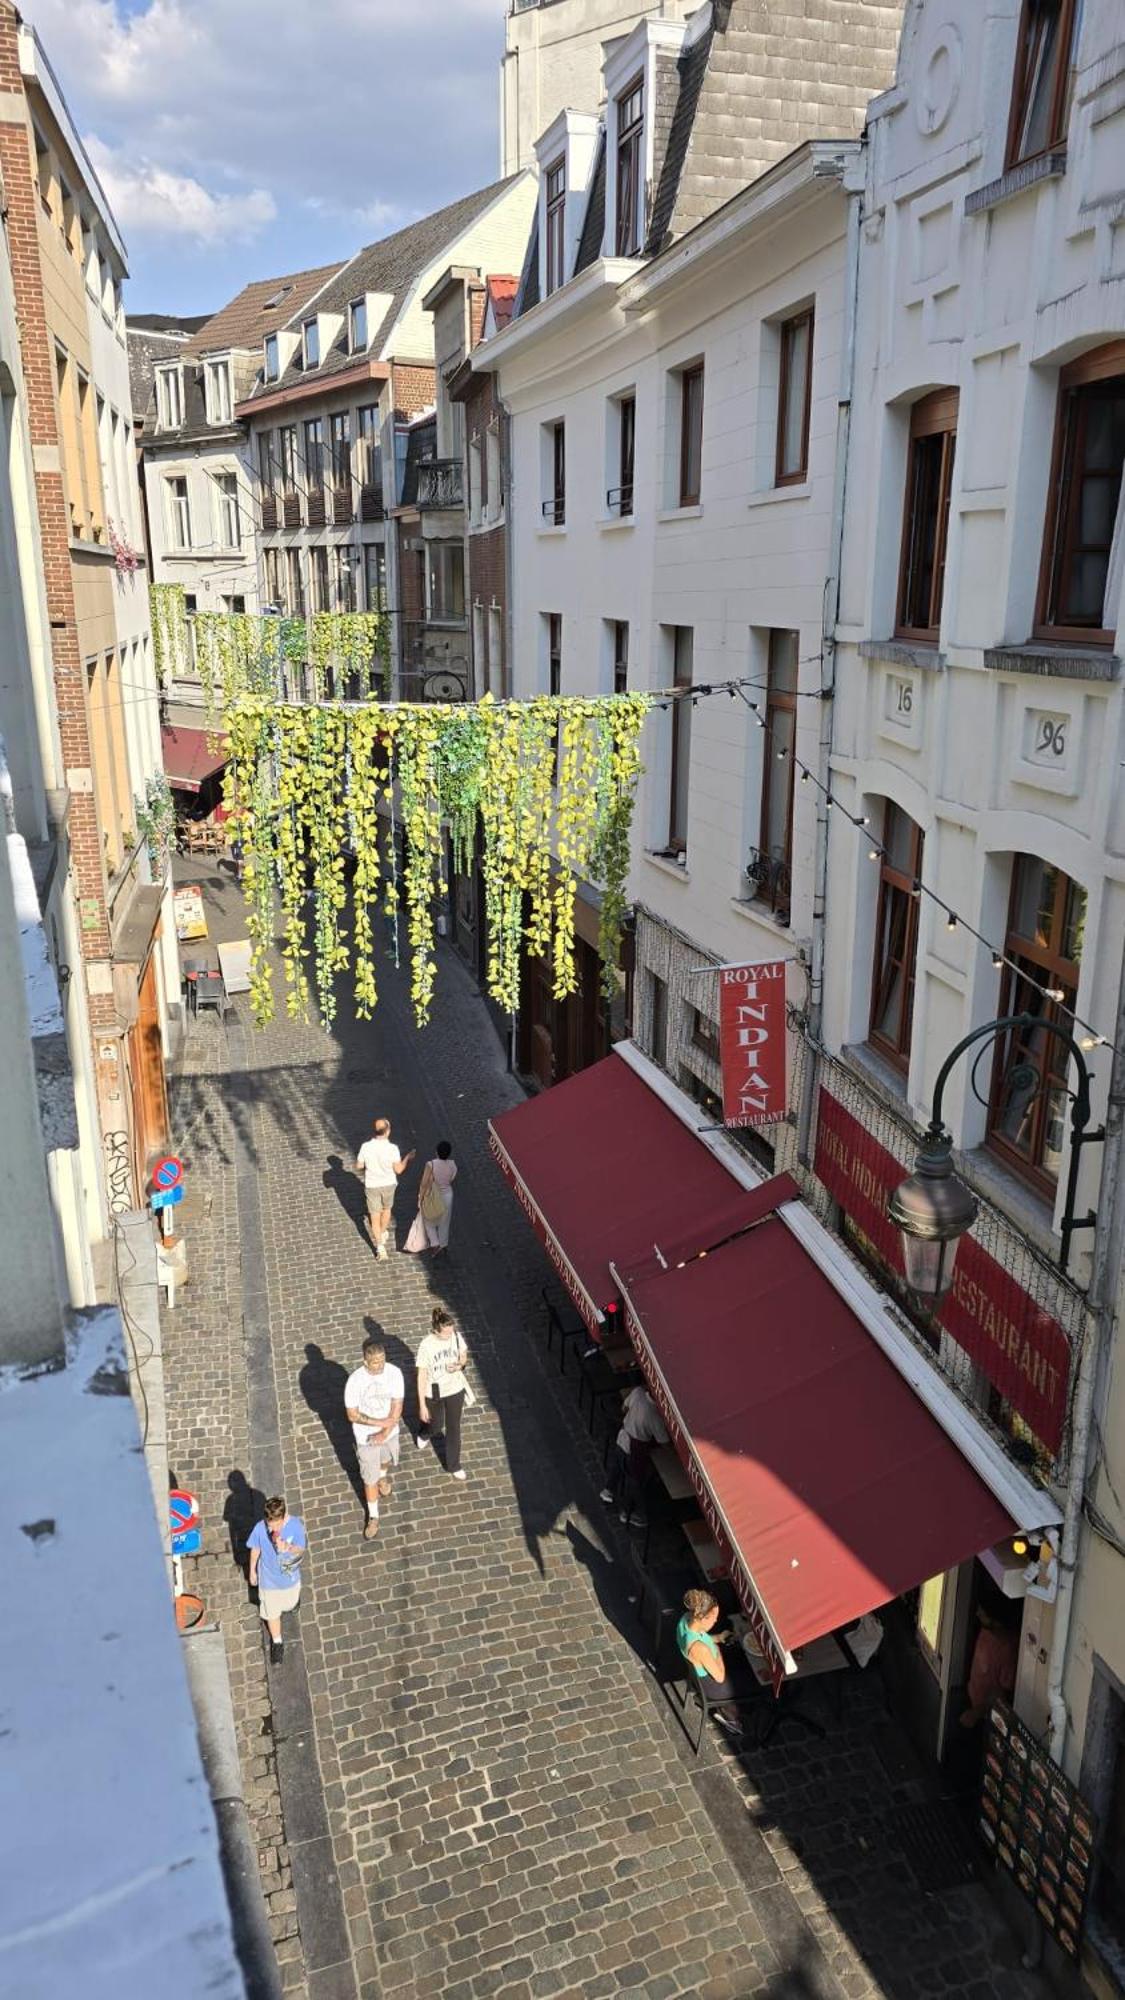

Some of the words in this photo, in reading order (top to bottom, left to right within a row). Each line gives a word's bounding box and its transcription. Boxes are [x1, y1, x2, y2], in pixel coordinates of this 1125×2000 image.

[897, 684, 913, 712] 16
[1034, 720, 1065, 755] 96
[724, 965, 782, 984] ROYAL
[736, 982, 771, 1114] INDIAN
[725, 1110, 785, 1128] RESTAURANT
[626, 1311, 680, 1441] RESTAURANT
[688, 1455, 723, 1547] ROYAL
[730, 1553, 778, 1673] INDIAN
